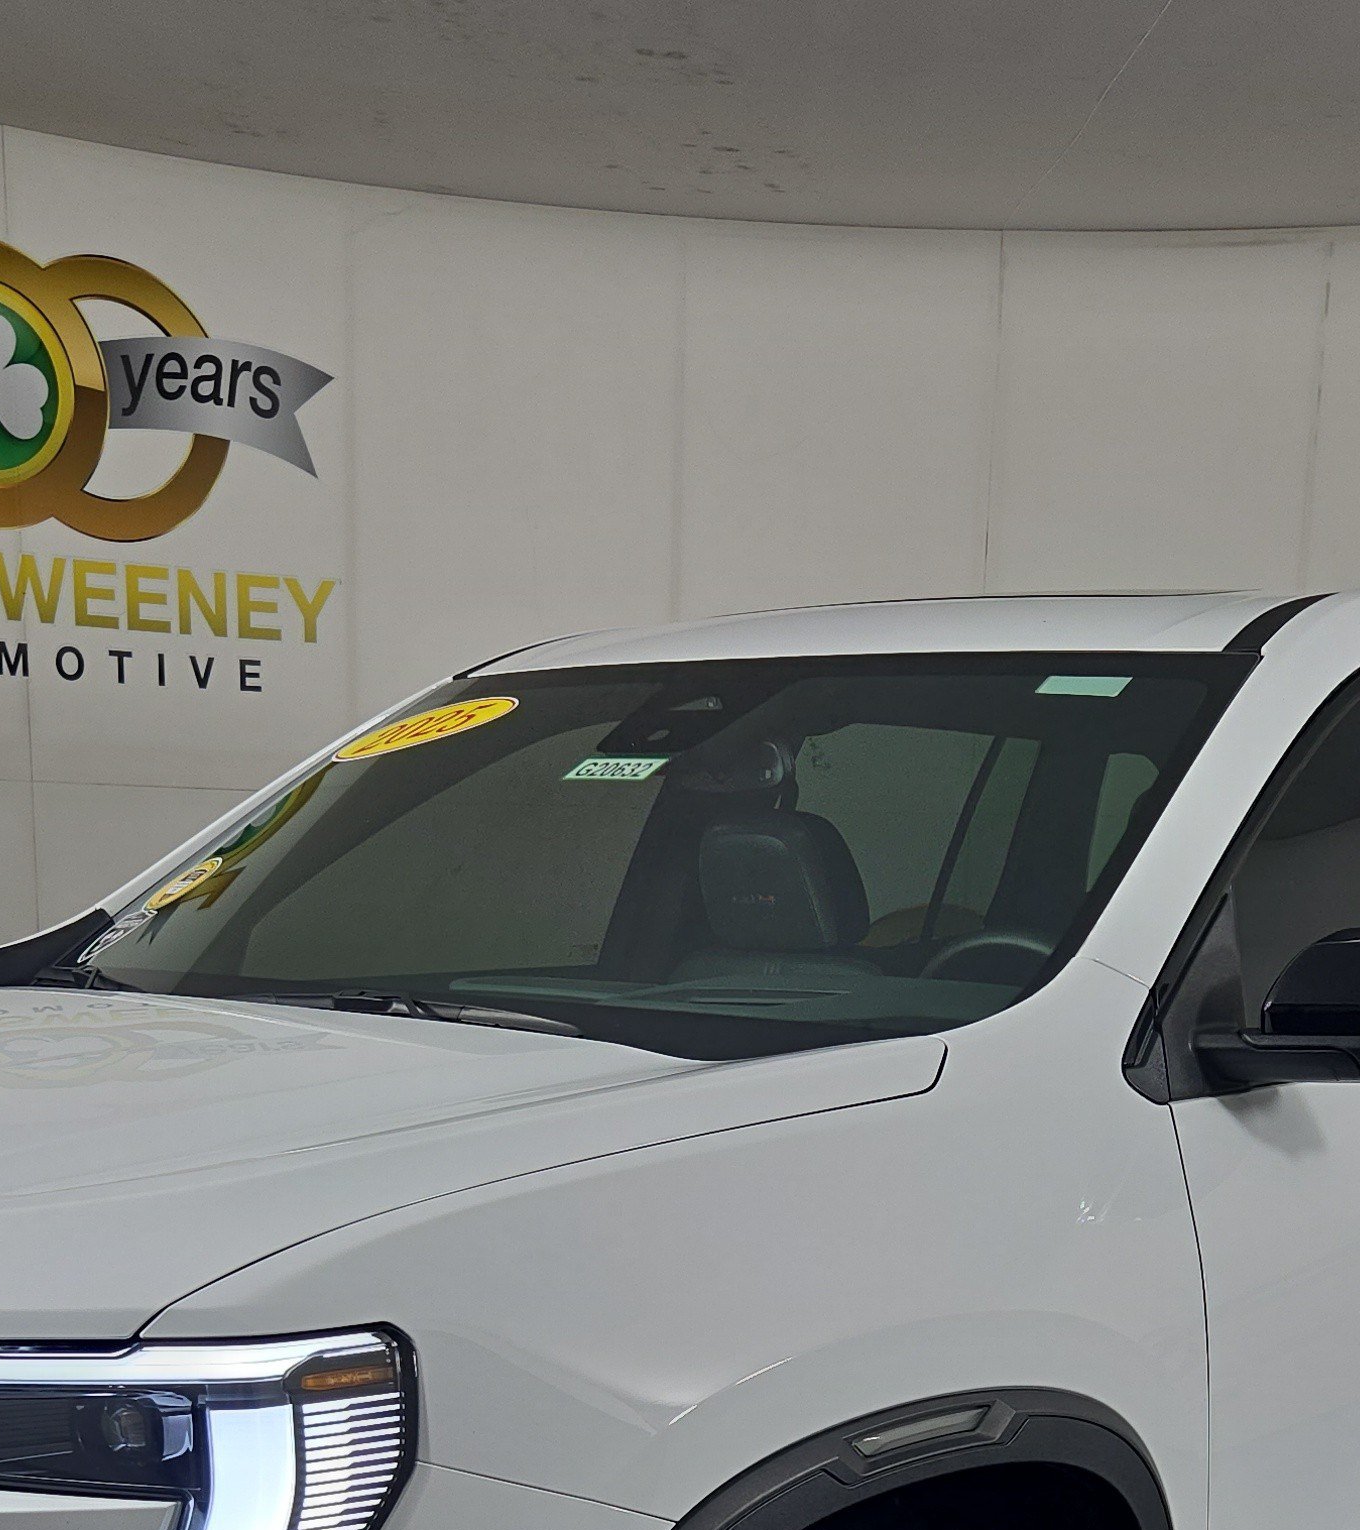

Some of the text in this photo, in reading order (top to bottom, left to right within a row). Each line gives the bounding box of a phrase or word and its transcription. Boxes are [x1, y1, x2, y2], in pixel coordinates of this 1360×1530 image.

[120, 350, 283, 420] years
[351, 702, 498, 755] 2025
[575, 762, 654, 777] G20632
